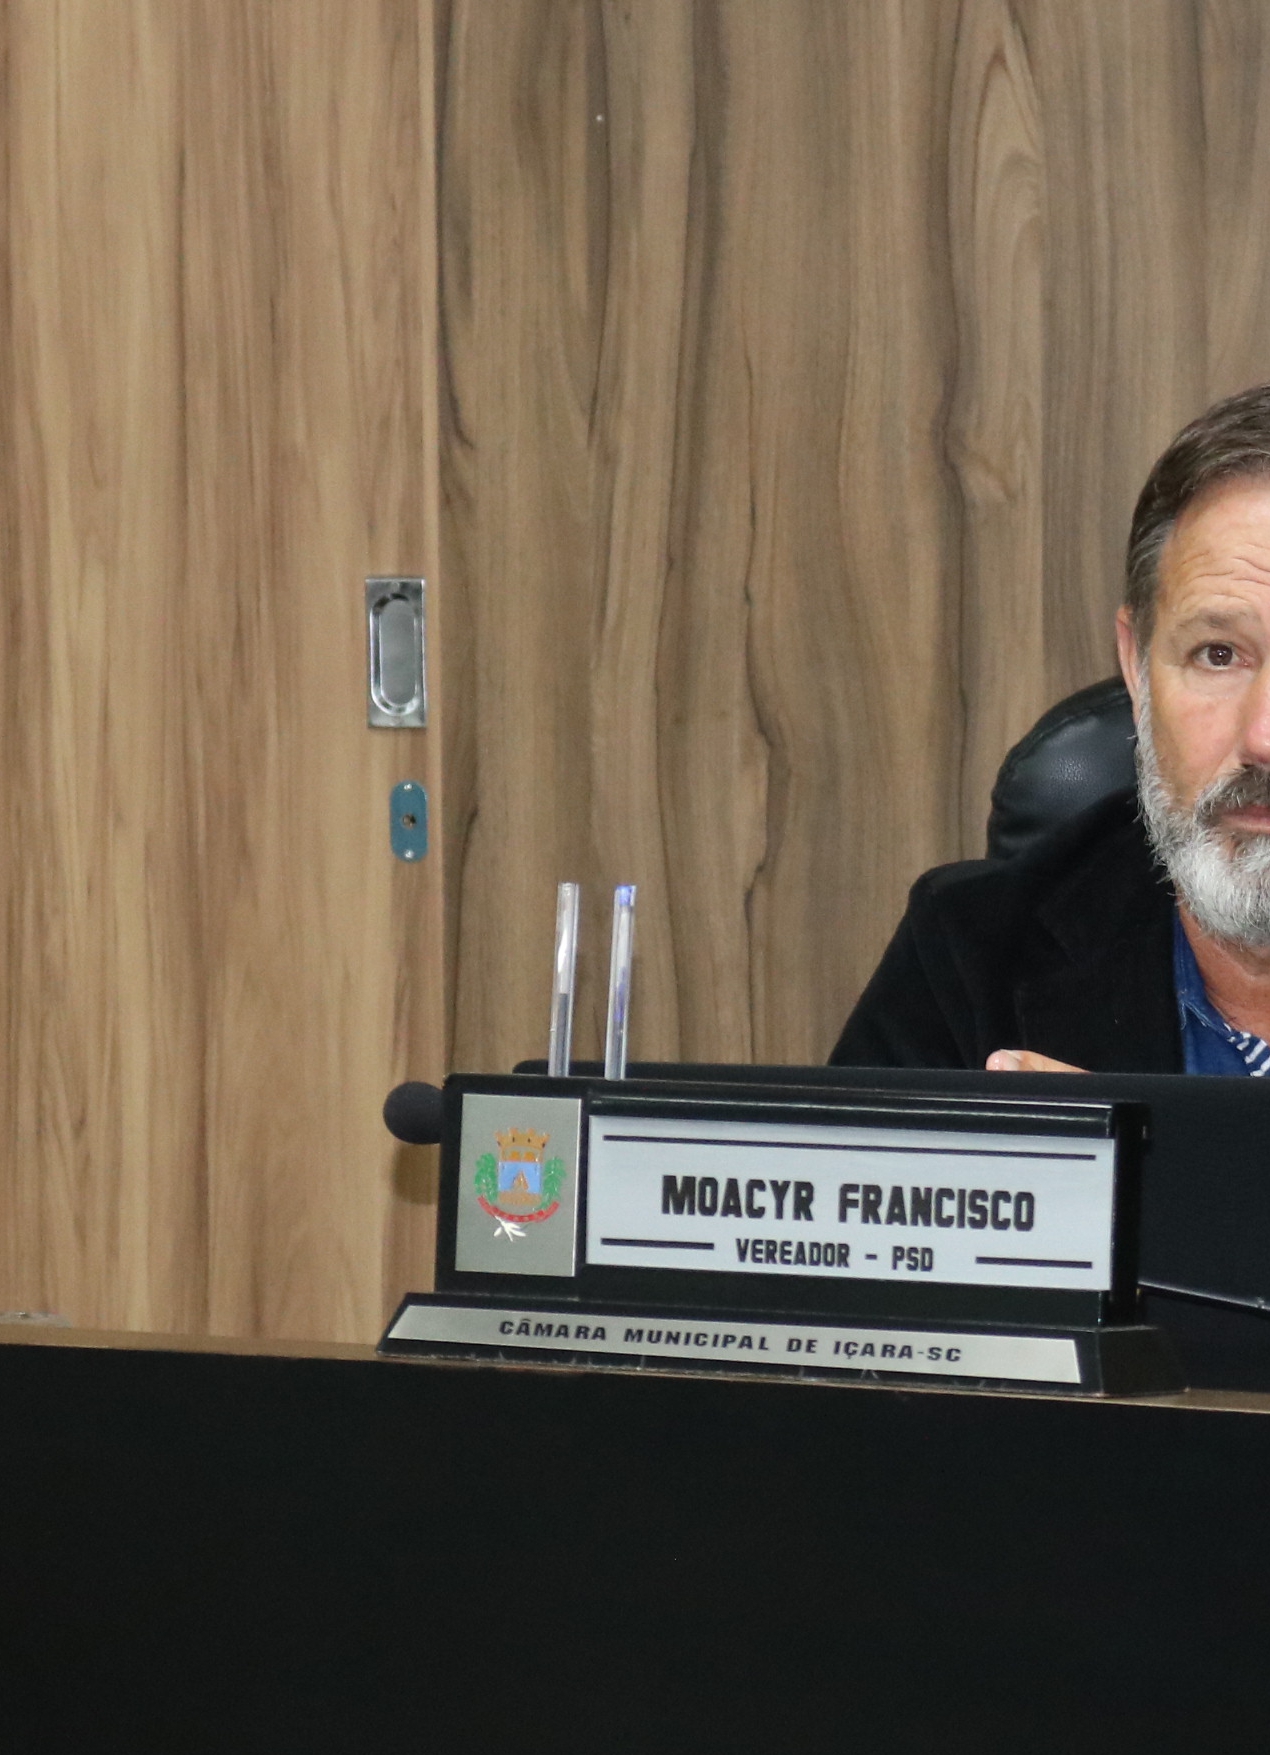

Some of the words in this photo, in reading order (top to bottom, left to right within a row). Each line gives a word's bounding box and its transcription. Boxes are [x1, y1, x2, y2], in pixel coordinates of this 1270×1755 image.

[661, 1174, 815, 1222] MOACYR
[838, 1183, 1035, 1232] FRANCISCO
[735, 1238, 850, 1268] VEREADOR
[892, 1245, 934, 1272] PSD
[498, 1318, 608, 1341] CÂMARA
[623, 1328, 770, 1351] MUNICIPAL
[786, 1338, 818, 1354] DE
[833, 1341, 962, 1362] IÇARA-SC
